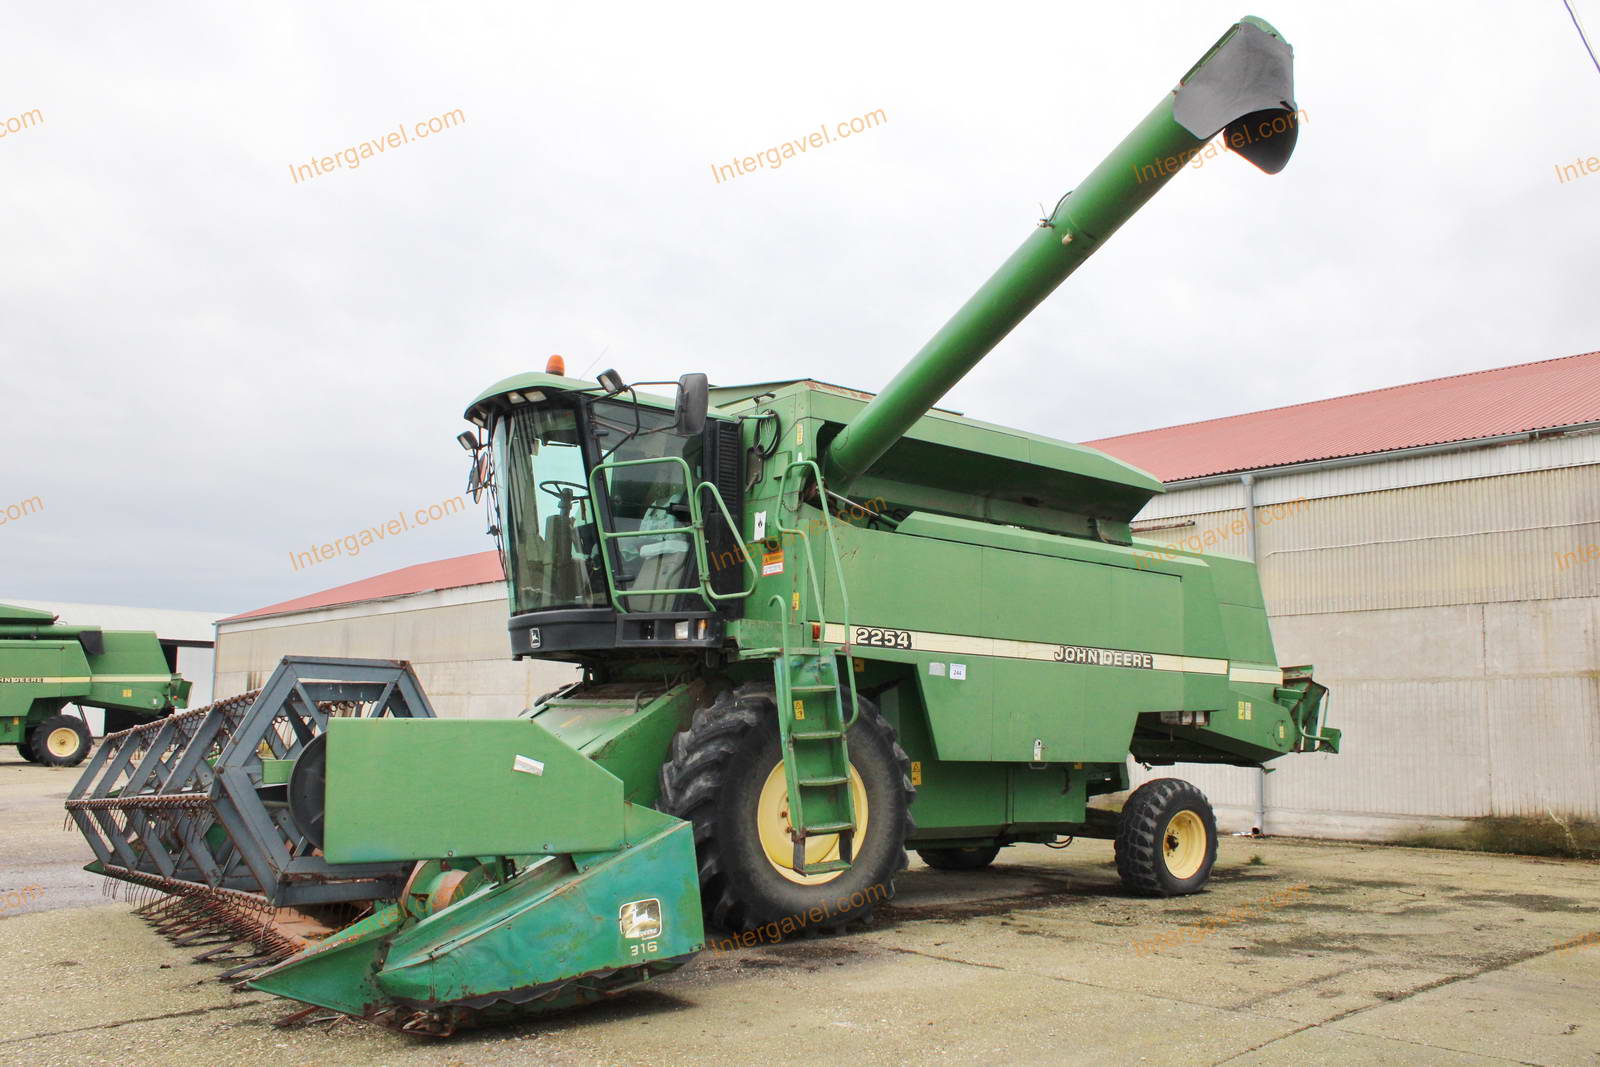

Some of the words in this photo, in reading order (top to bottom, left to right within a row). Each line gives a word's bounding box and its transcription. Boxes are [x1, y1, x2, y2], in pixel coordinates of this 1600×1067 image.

[855, 627, 912, 650] 2254
[1054, 645, 1099, 665] JOHN
[1100, 650, 1153, 669] DEERE
[630, 941, 658, 957] 316
